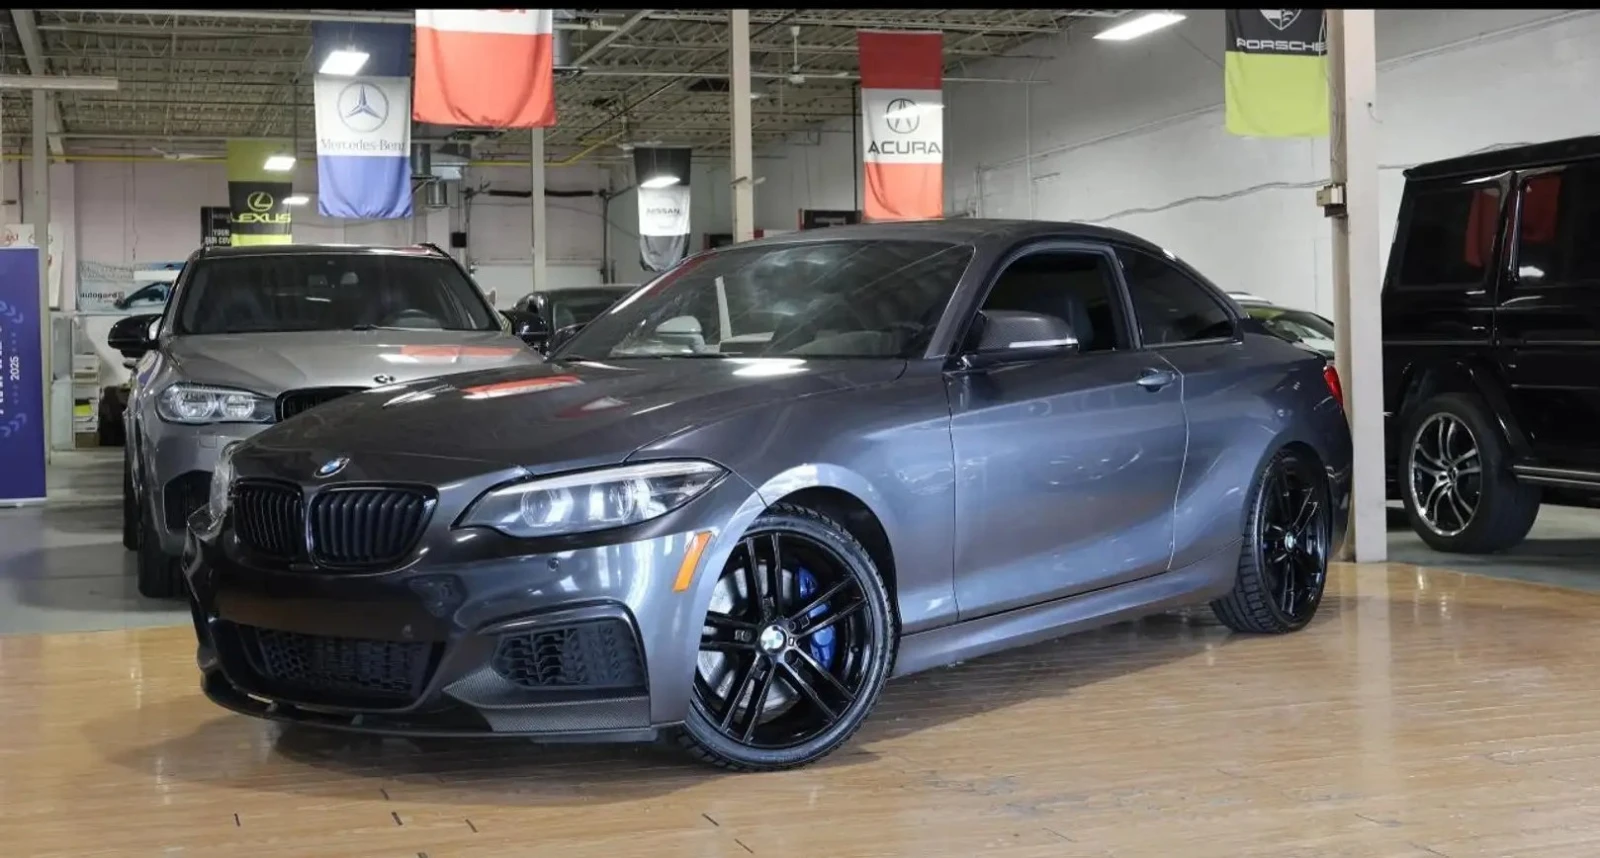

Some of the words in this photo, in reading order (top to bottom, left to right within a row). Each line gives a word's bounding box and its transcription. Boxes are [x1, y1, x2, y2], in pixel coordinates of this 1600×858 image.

[1236, 38, 1326, 52] PORSCHE
[868, 140, 942, 155] ACURA
[230, 212, 291, 223] LEXUS
[646, 207, 680, 215] NISSAN
[10, 356, 20, 381] 2025
